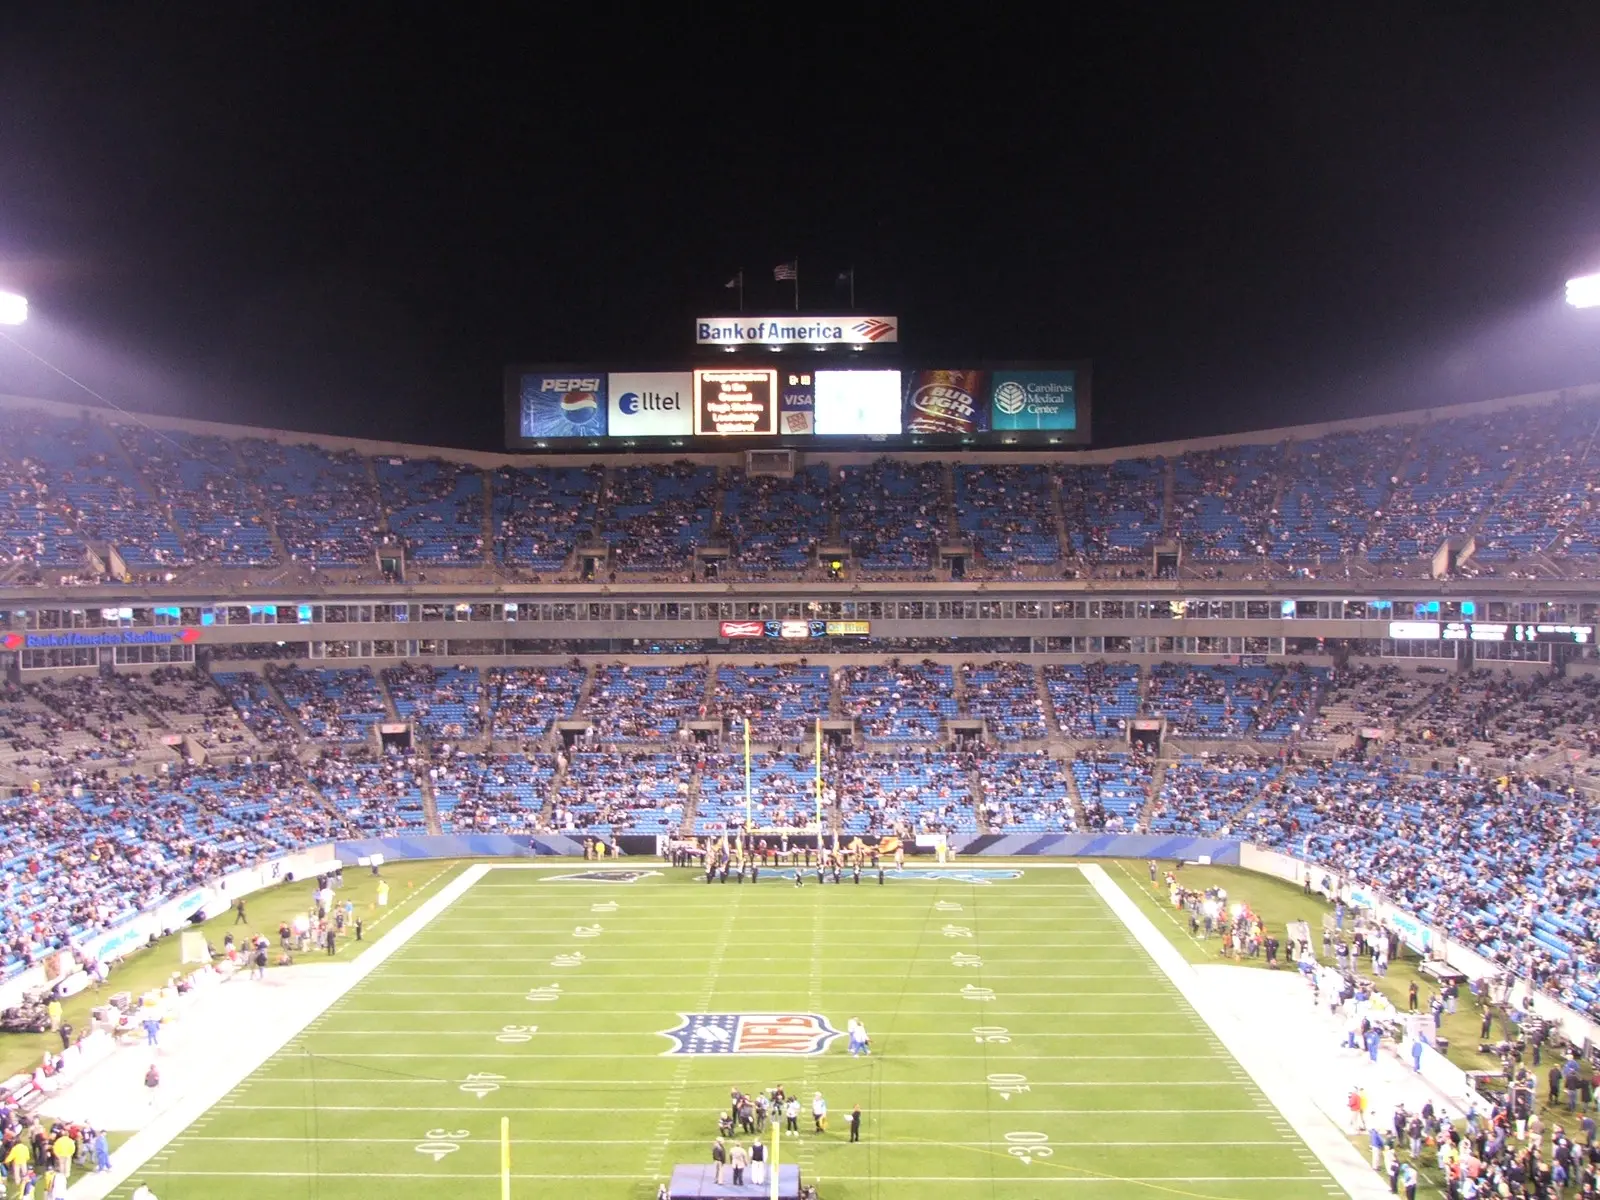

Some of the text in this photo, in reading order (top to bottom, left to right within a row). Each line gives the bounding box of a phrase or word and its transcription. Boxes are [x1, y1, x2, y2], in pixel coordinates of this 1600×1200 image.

[699, 323, 843, 339] Bank of America
[541, 378, 600, 392] PEPSI
[1027, 383, 1073, 393] Carolinas
[625, 391, 680, 412] alltel
[784, 394, 812, 405] VISA
[930, 387, 973, 405] BUD
[1027, 394, 1065, 403] Medical
[920, 396, 975, 416] LIGHT
[1027, 404, 1058, 414] Center
[27, 634, 58, 647] Bank
[71, 633, 121, 646] America
[124, 631, 173, 644] Stadium
[414, 1128, 470, 1153] 30
[1004, 1132, 1054, 1157] 30
